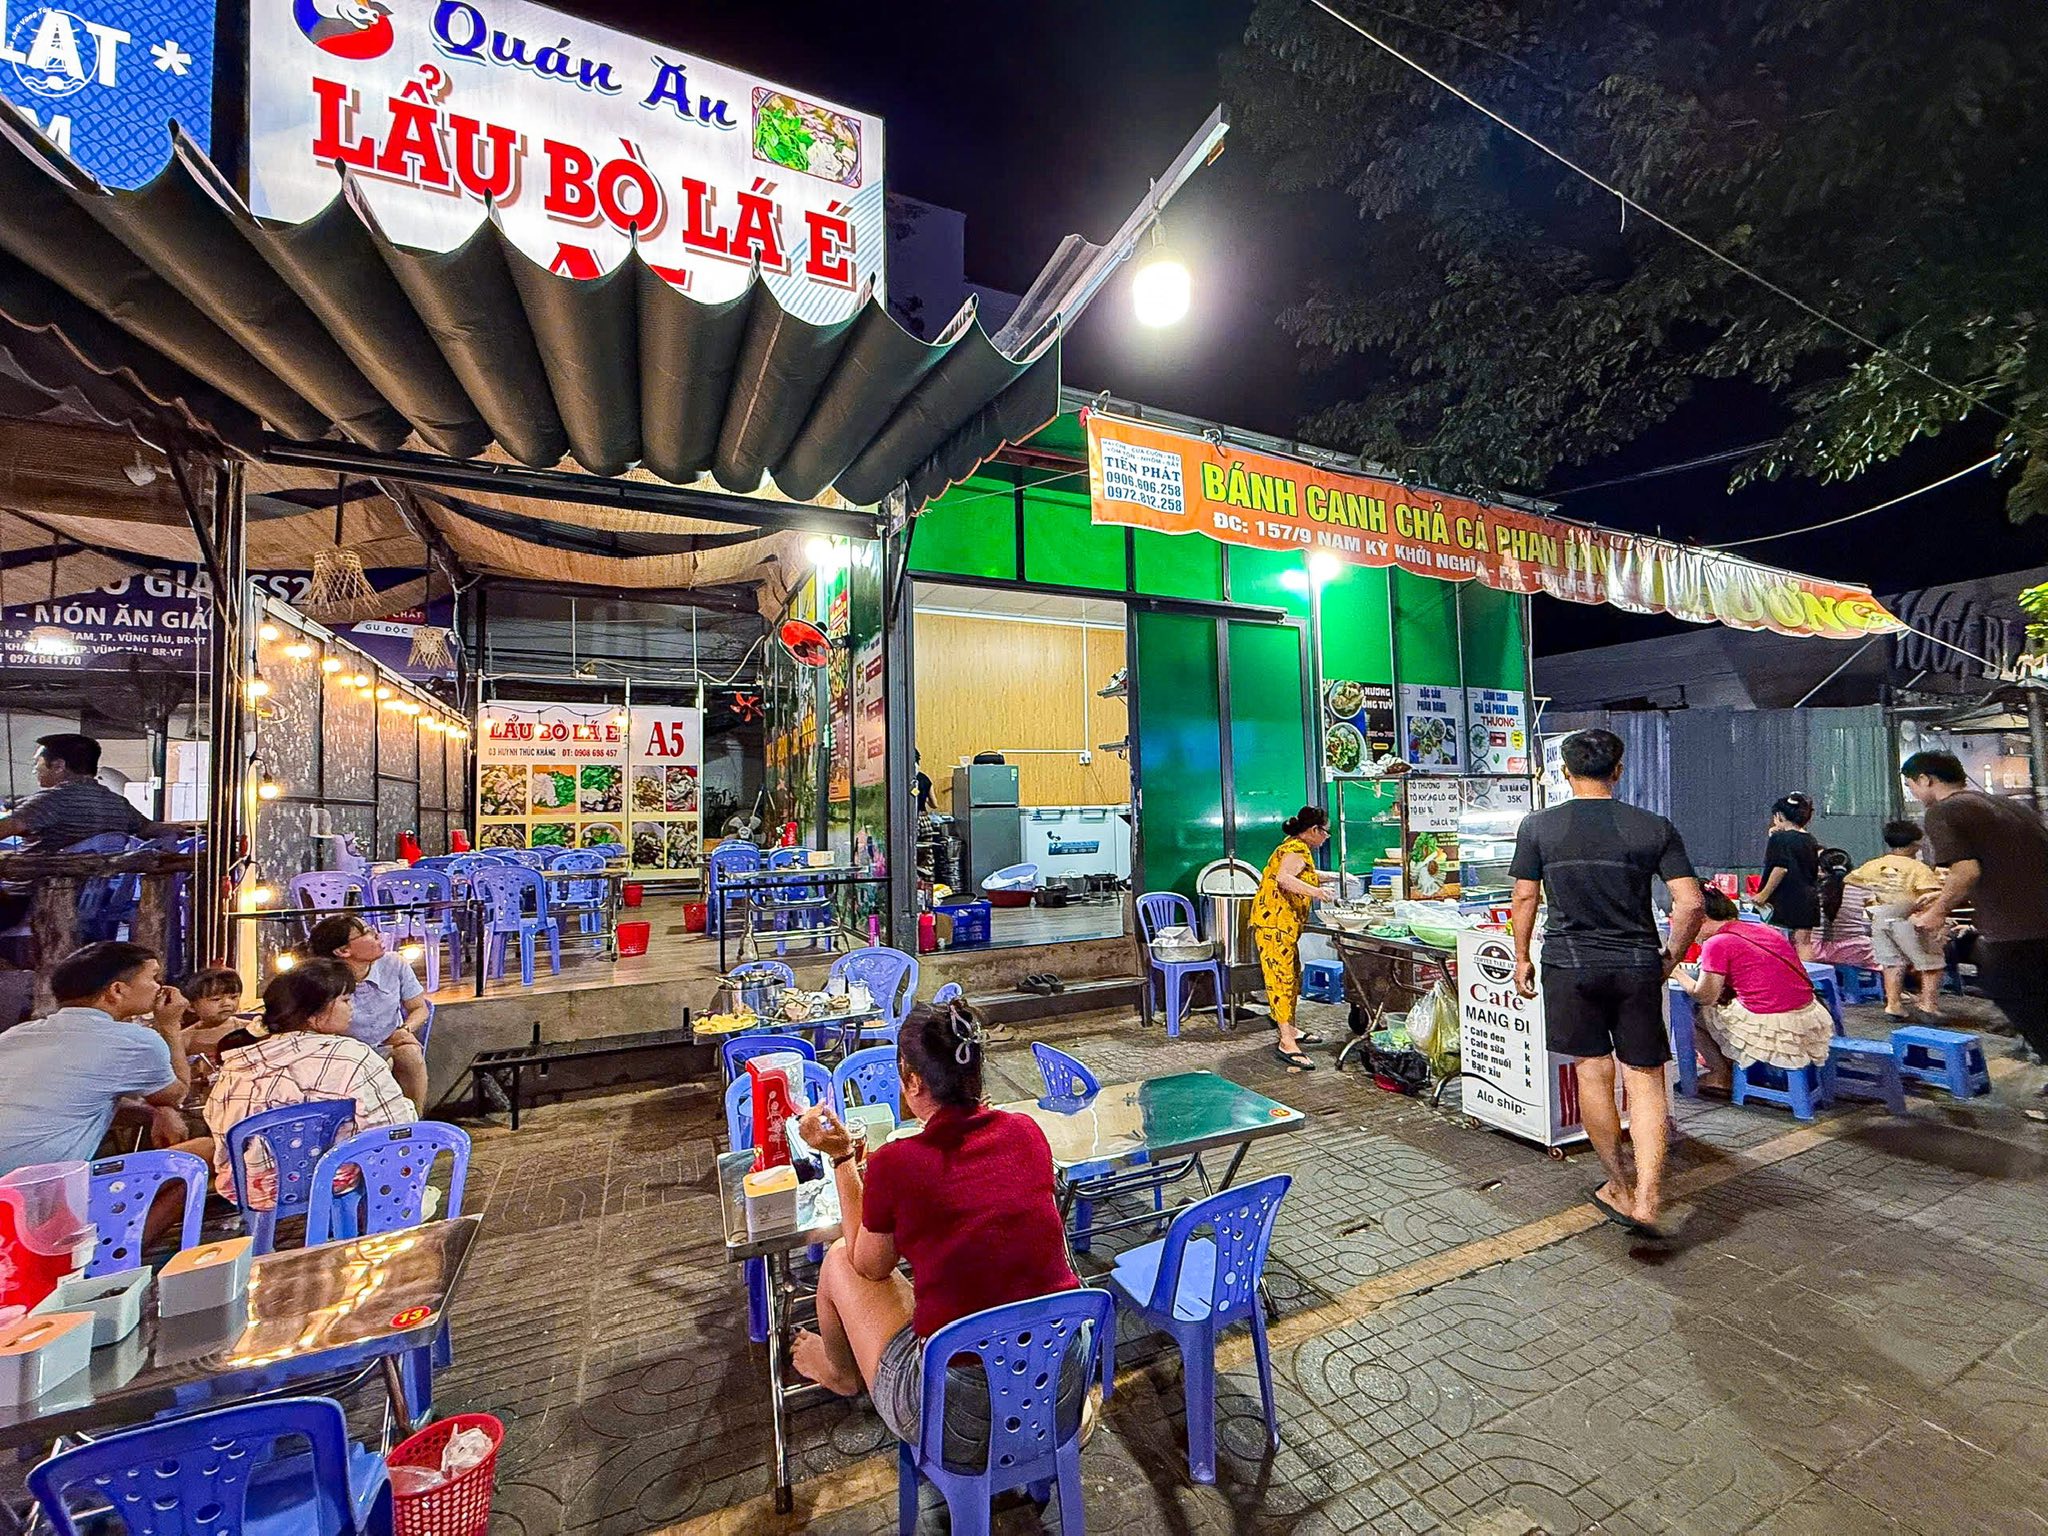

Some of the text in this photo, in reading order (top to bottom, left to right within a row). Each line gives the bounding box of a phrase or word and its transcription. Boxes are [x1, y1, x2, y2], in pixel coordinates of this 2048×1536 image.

[432, 0, 738, 127] Quán Ăn
[312, 64, 849, 283] LẨU BÒ LÁ É
[1104, 456, 1181, 482] TIẾN PHÁT
[1106, 470, 1181, 497] 0906.606.258
[1107, 485, 1182, 512] 0972.812.258
[1202, 460, 1298, 518] BÁNH
[1305, 484, 1388, 535] CANH
[1394, 501, 1450, 546] CHẢ
[1455, 513, 1490, 553] CÁ
[1495, 524, 1559, 568] PHAN
[1213, 512, 1249, 534] ĐC:
[1255, 520, 1312, 544] 157/9
[1316, 531, 1361, 552] NAM
[1365, 539, 1390, 557] KỲ
[1394, 544, 1432, 566] KHỞI
[34, 602, 212, 630] MÓN ĂN GIẢ
[364, 624, 409, 635] GU ĐỘC
[118, 632, 149, 643] VŨNG
[489, 714, 533, 740] LẨU
[537, 719, 568, 740] BÒ
[644, 721, 685, 758] A5
[536, 747, 556, 757] KHÁNG
[1507, 795, 1522, 804] 35K
[1470, 983, 1524, 1011] Café
[1465, 1004, 1530, 1034] MANG ĐI
[1476, 1089, 1527, 1116] Alo ship:
